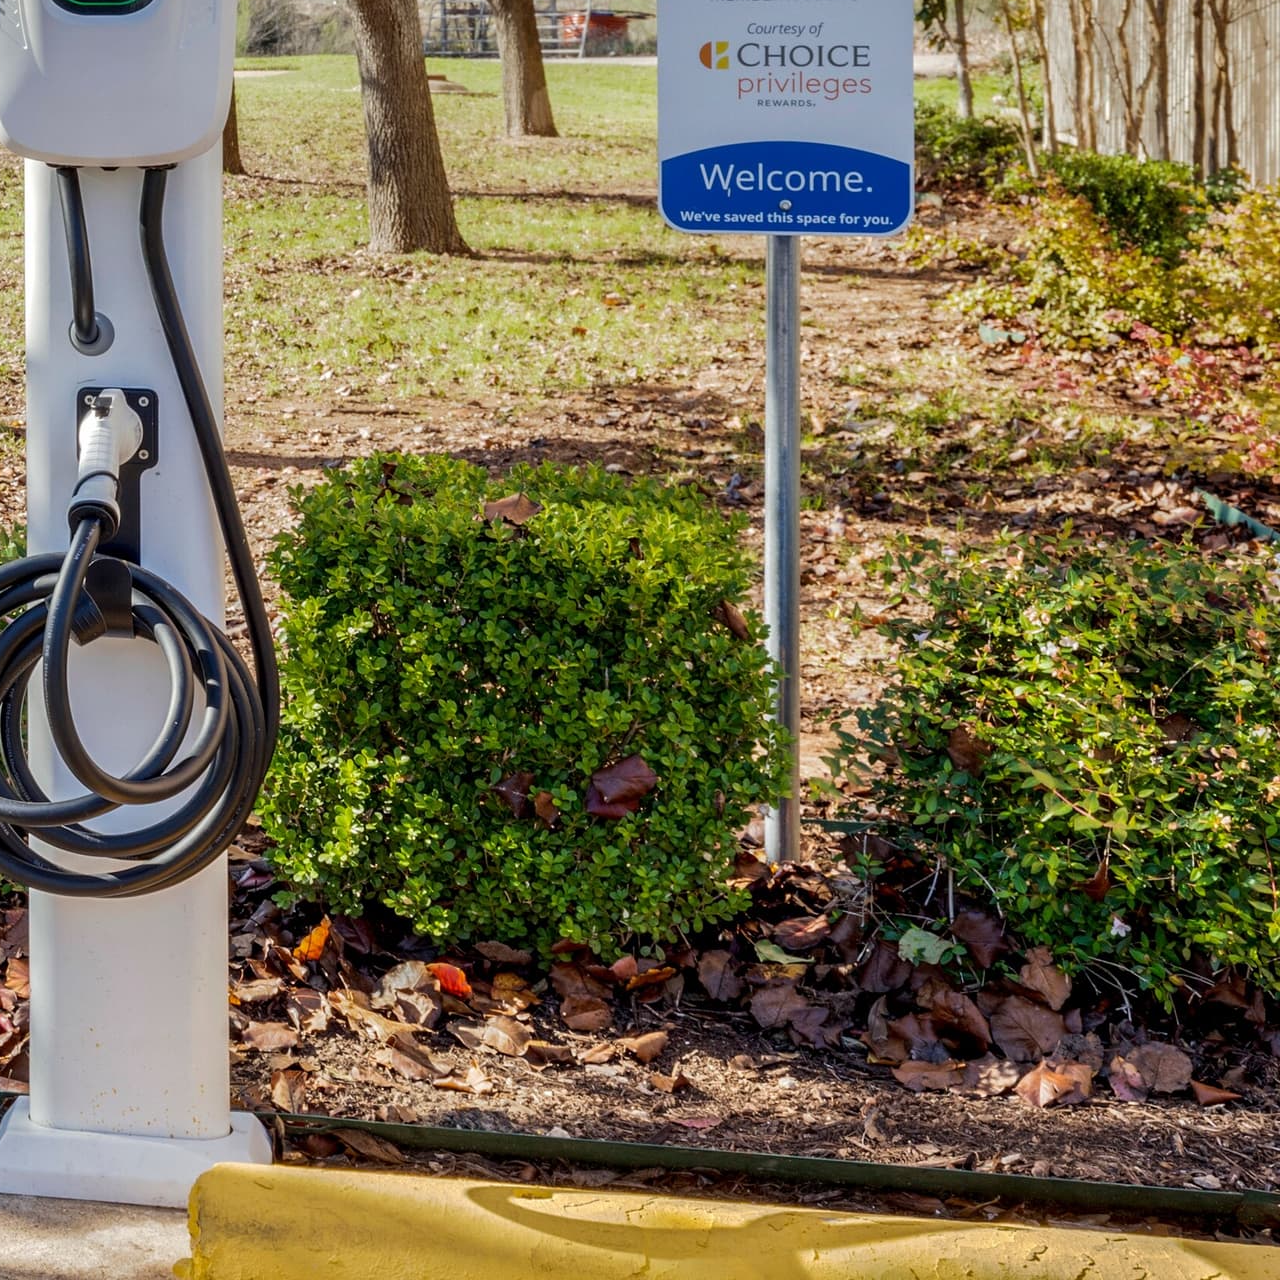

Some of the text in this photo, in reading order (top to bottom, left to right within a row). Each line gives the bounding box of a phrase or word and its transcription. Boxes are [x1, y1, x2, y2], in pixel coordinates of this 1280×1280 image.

[747, 22, 824, 38] Courtesy of
[737, 42, 871, 68] CHOICE
[738, 71, 872, 101] privileges
[699, 162, 873, 193] Welcome.
[680, 211, 893, 228] We've saved this space for you.
